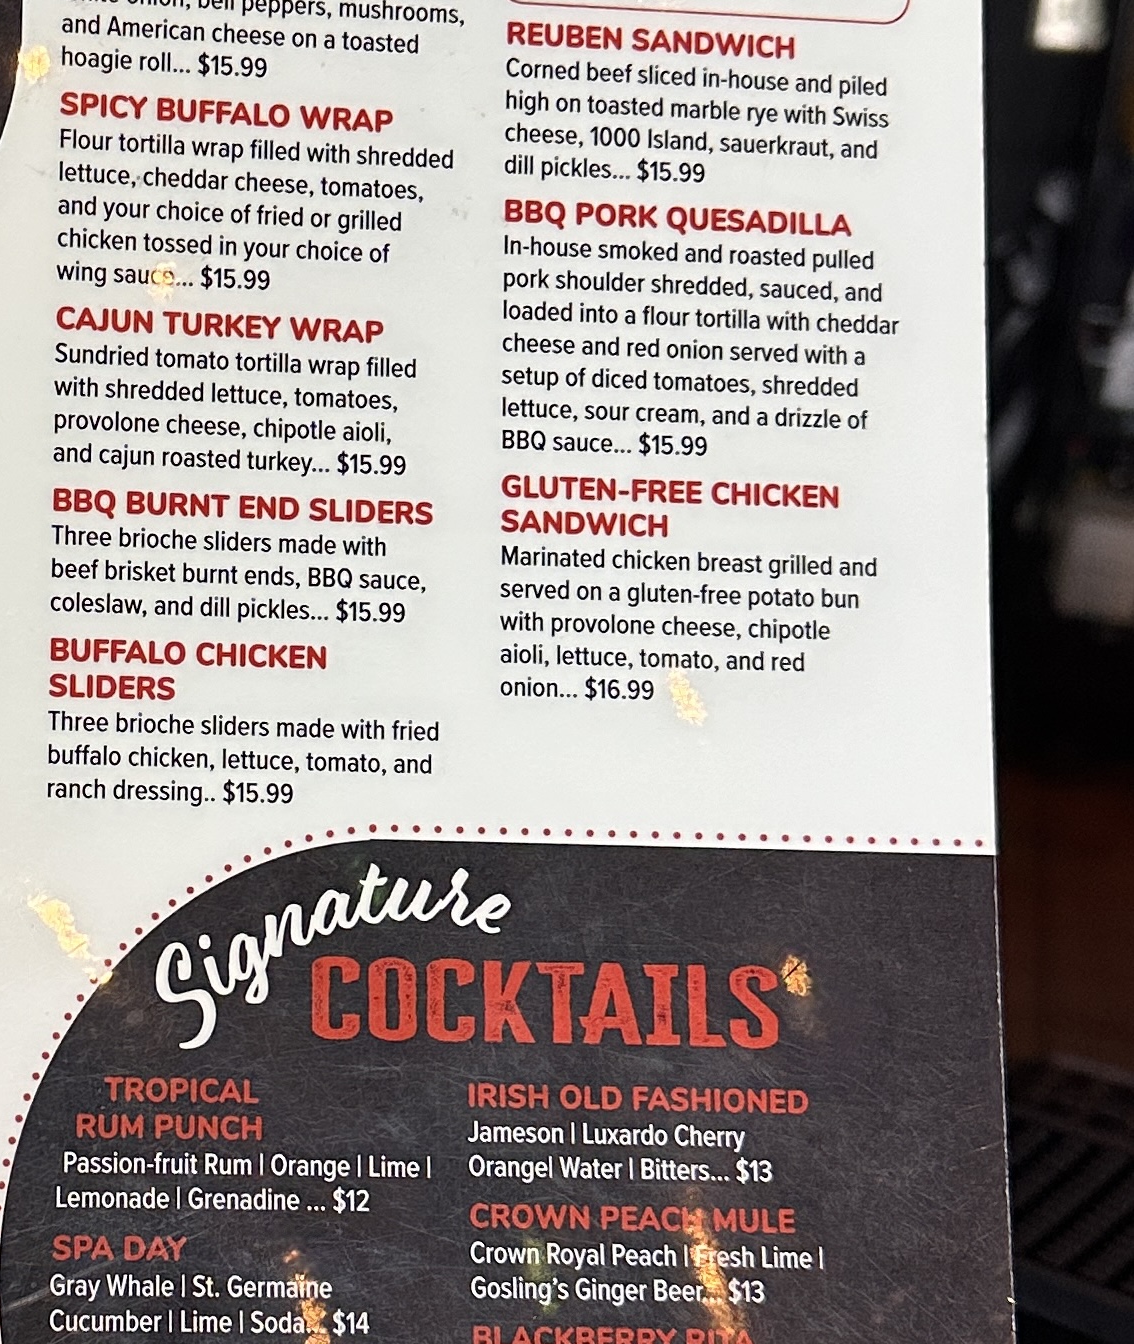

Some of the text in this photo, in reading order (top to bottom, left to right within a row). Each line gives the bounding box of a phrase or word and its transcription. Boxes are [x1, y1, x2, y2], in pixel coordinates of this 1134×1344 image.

[507, 21, 795, 60] REUBEN SANDWICH
[506, 57, 887, 99] Corned beef sliced in-house and piled
[504, 199, 852, 237] BBQ PORK QUESADILLA
[56, 306, 384, 344] CAJUN TURKEY WRAP
[53, 488, 433, 526] BBQ BURNT END SLIDERS
[155, 862, 514, 1050] Signature
[310, 955, 781, 1049] COCKTAILS
[104, 1076, 259, 1104] TROPICAL
[468, 1082, 809, 1114] IRISH OLD FASHIONED
[76, 1113, 263, 1141] RUM PUNCH
[52, 1235, 188, 1261] SPA DAY
